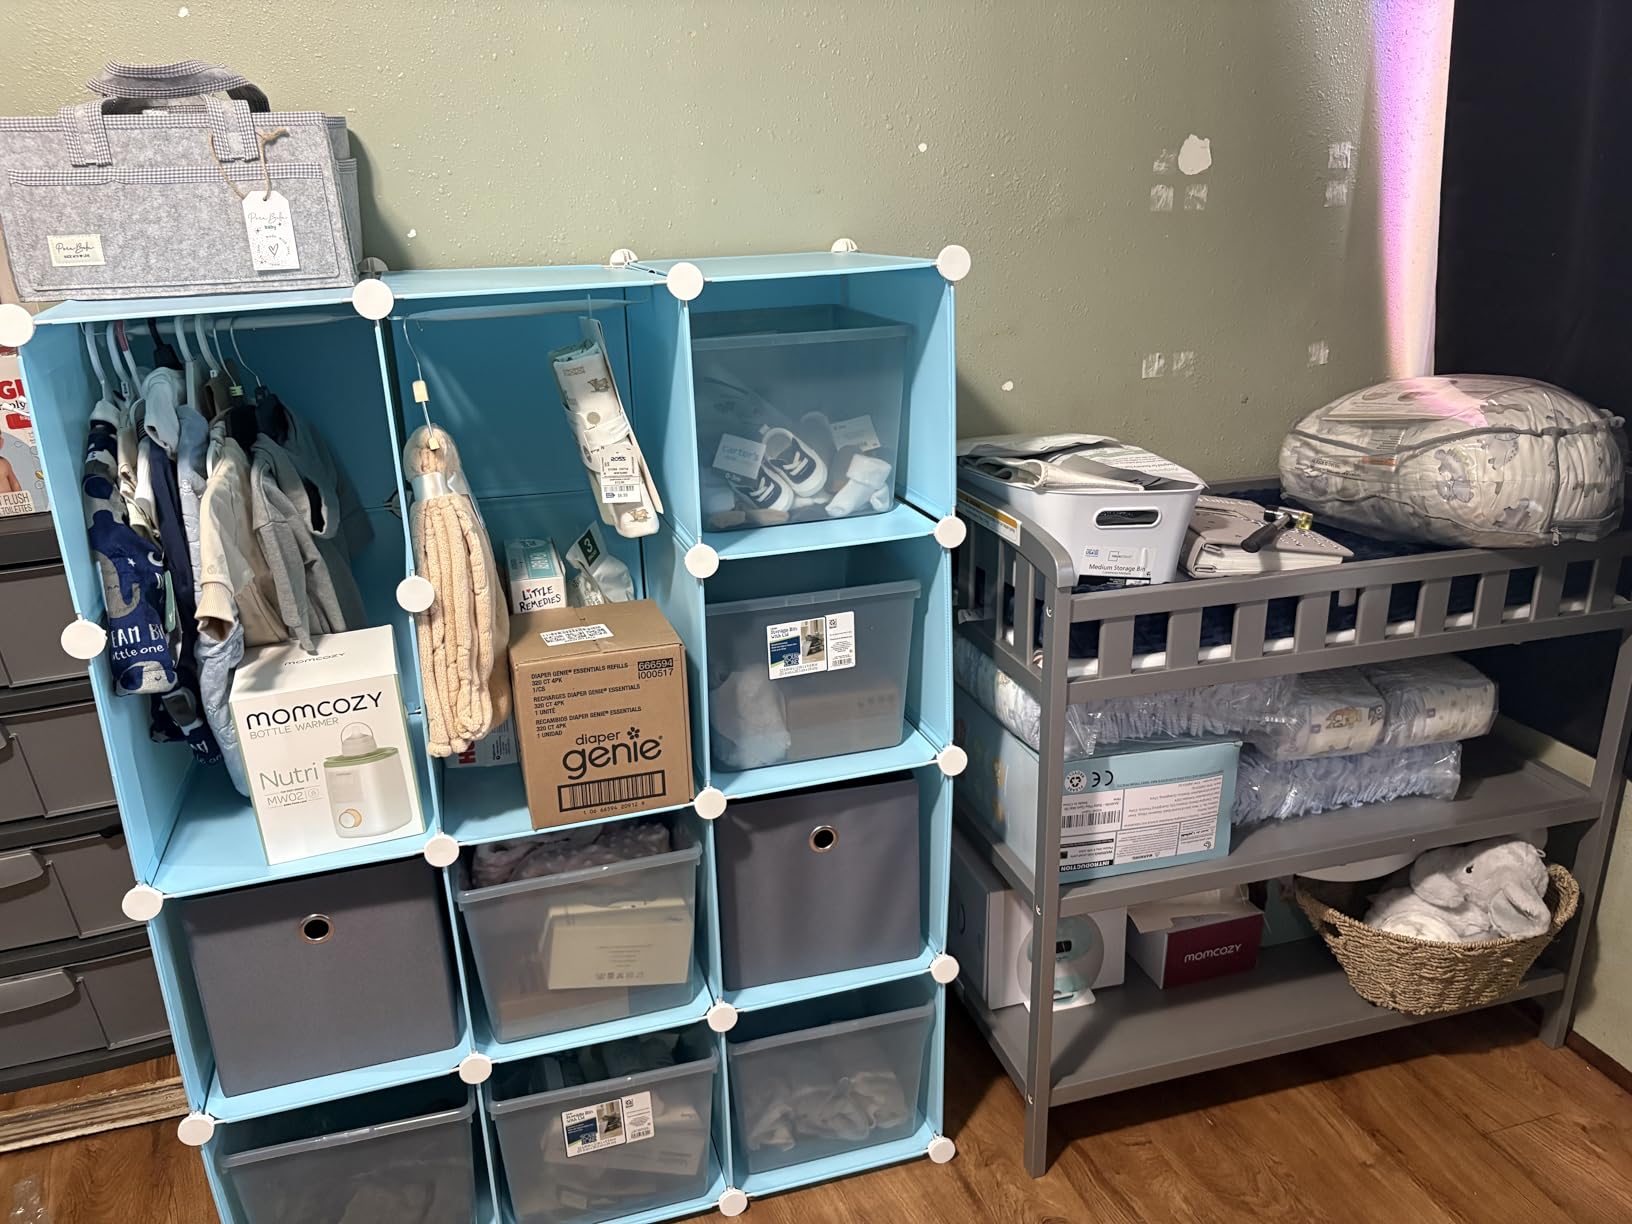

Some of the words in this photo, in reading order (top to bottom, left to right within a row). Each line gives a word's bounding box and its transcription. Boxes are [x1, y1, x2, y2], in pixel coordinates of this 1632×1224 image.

[4, 492, 30, 505] FLUSH
[584, 538, 592, 552] 3
[140, 644, 164, 654] one
[532, 668, 552, 679] DIAPER
[573, 665, 606, 674] ESSENTIALS
[638, 658, 673, 671] 666594
[534, 693, 566, 702] RECHARGES
[568, 690, 587, 698] DIAPER
[608, 684, 640, 692] ESSENTIALS
[246, 692, 382, 730] momcozy
[536, 716, 568, 725] RECAMBIOS
[569, 713, 589, 721] DIAPER
[610, 706, 642, 716] ESSENTIALS
[250, 725, 292, 740] BOTTLE
[295, 717, 339, 732] WARMER
[576, 731, 620, 746] diaper
[260, 762, 318, 790] Nutri
[1061, 860, 1109, 871] INTRODUCTION
[1184, 943, 1242, 963] momcozy
